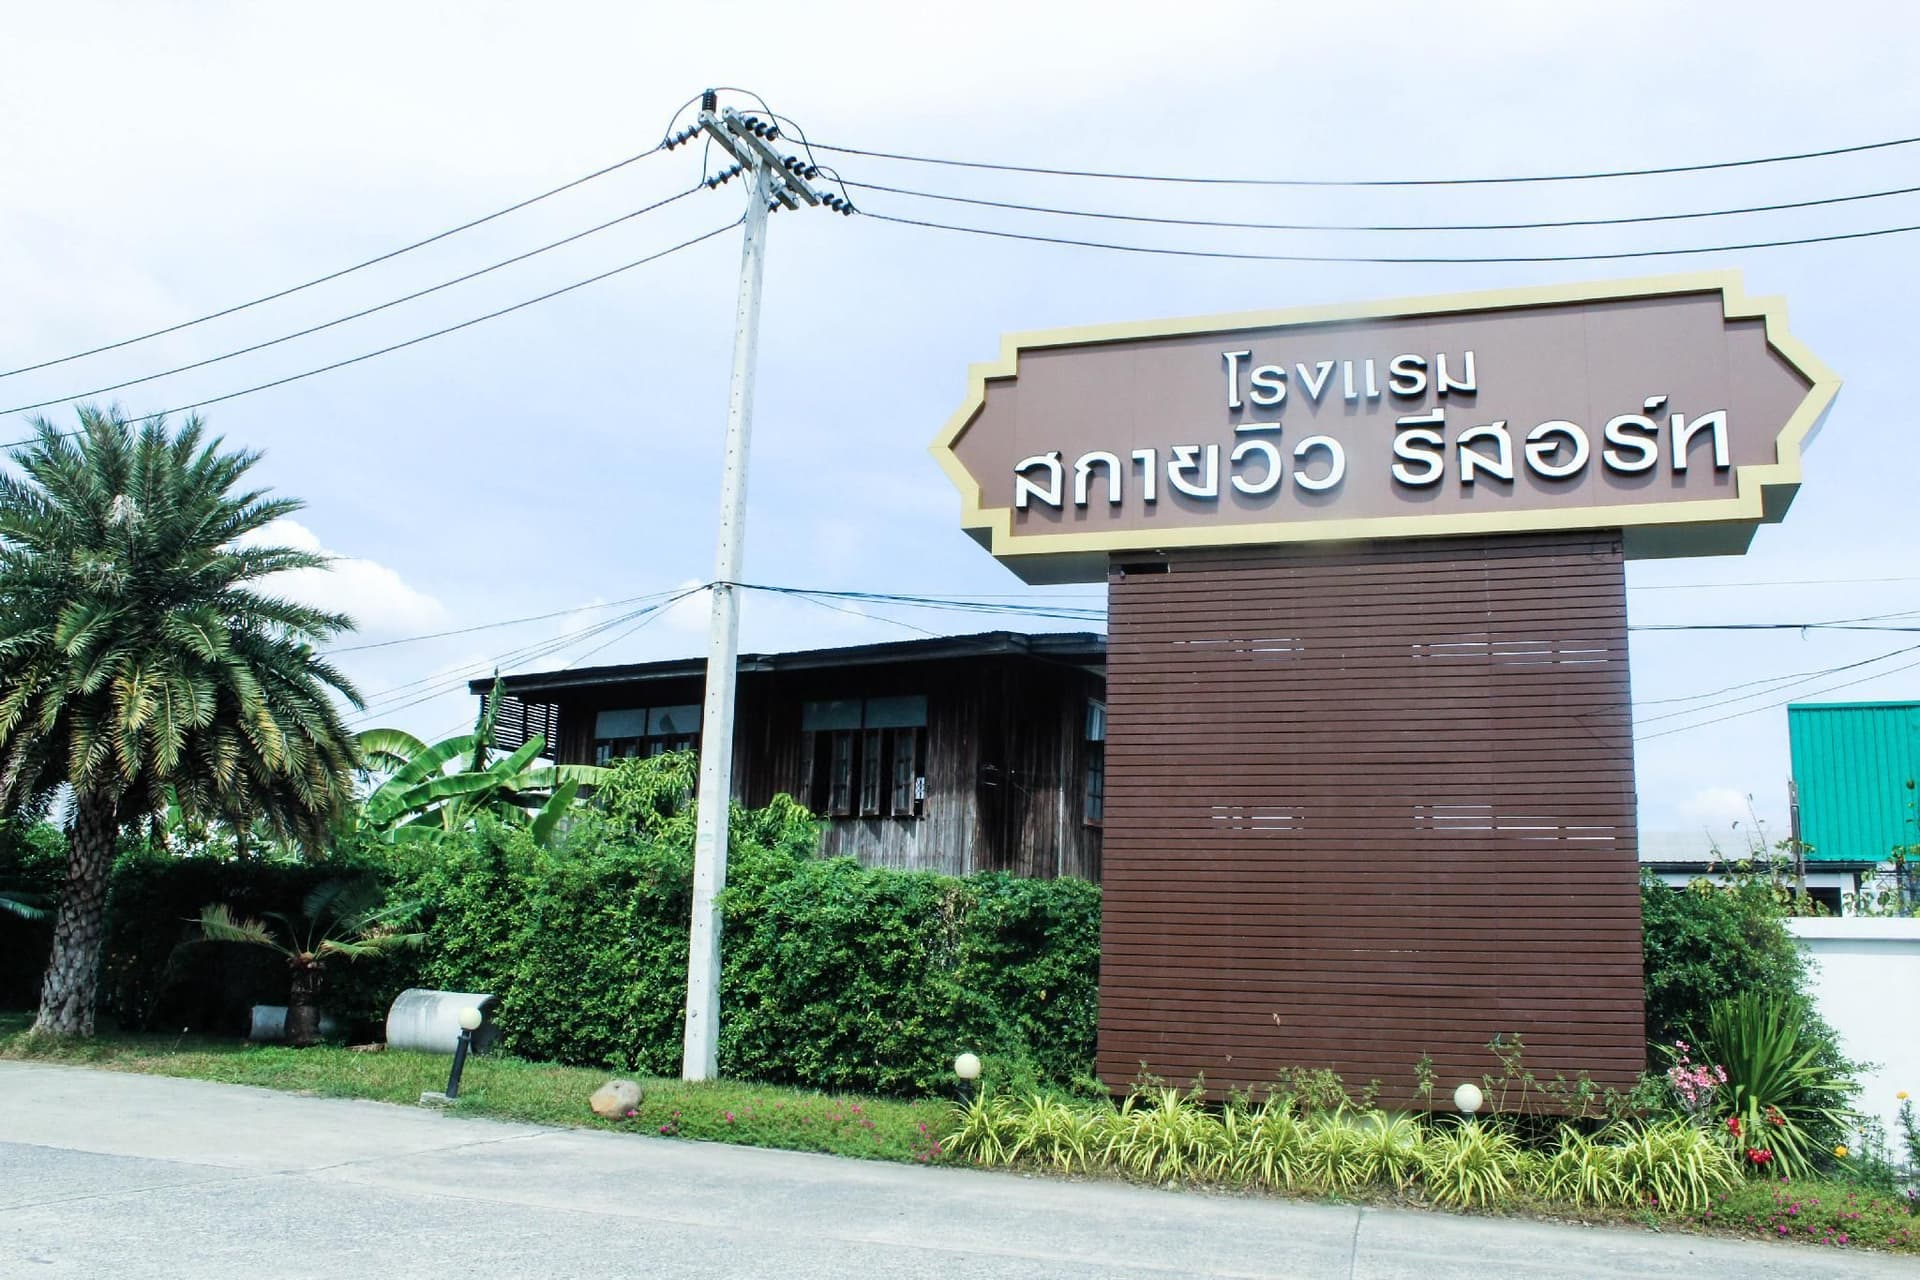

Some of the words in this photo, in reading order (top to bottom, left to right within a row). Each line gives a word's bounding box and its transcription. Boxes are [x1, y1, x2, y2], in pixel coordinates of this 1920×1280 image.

[1222, 350, 1477, 408] โรงแรม
[1014, 422, 1346, 508] สกายวิว
[1391, 395, 1729, 486] รีสอร์ท
